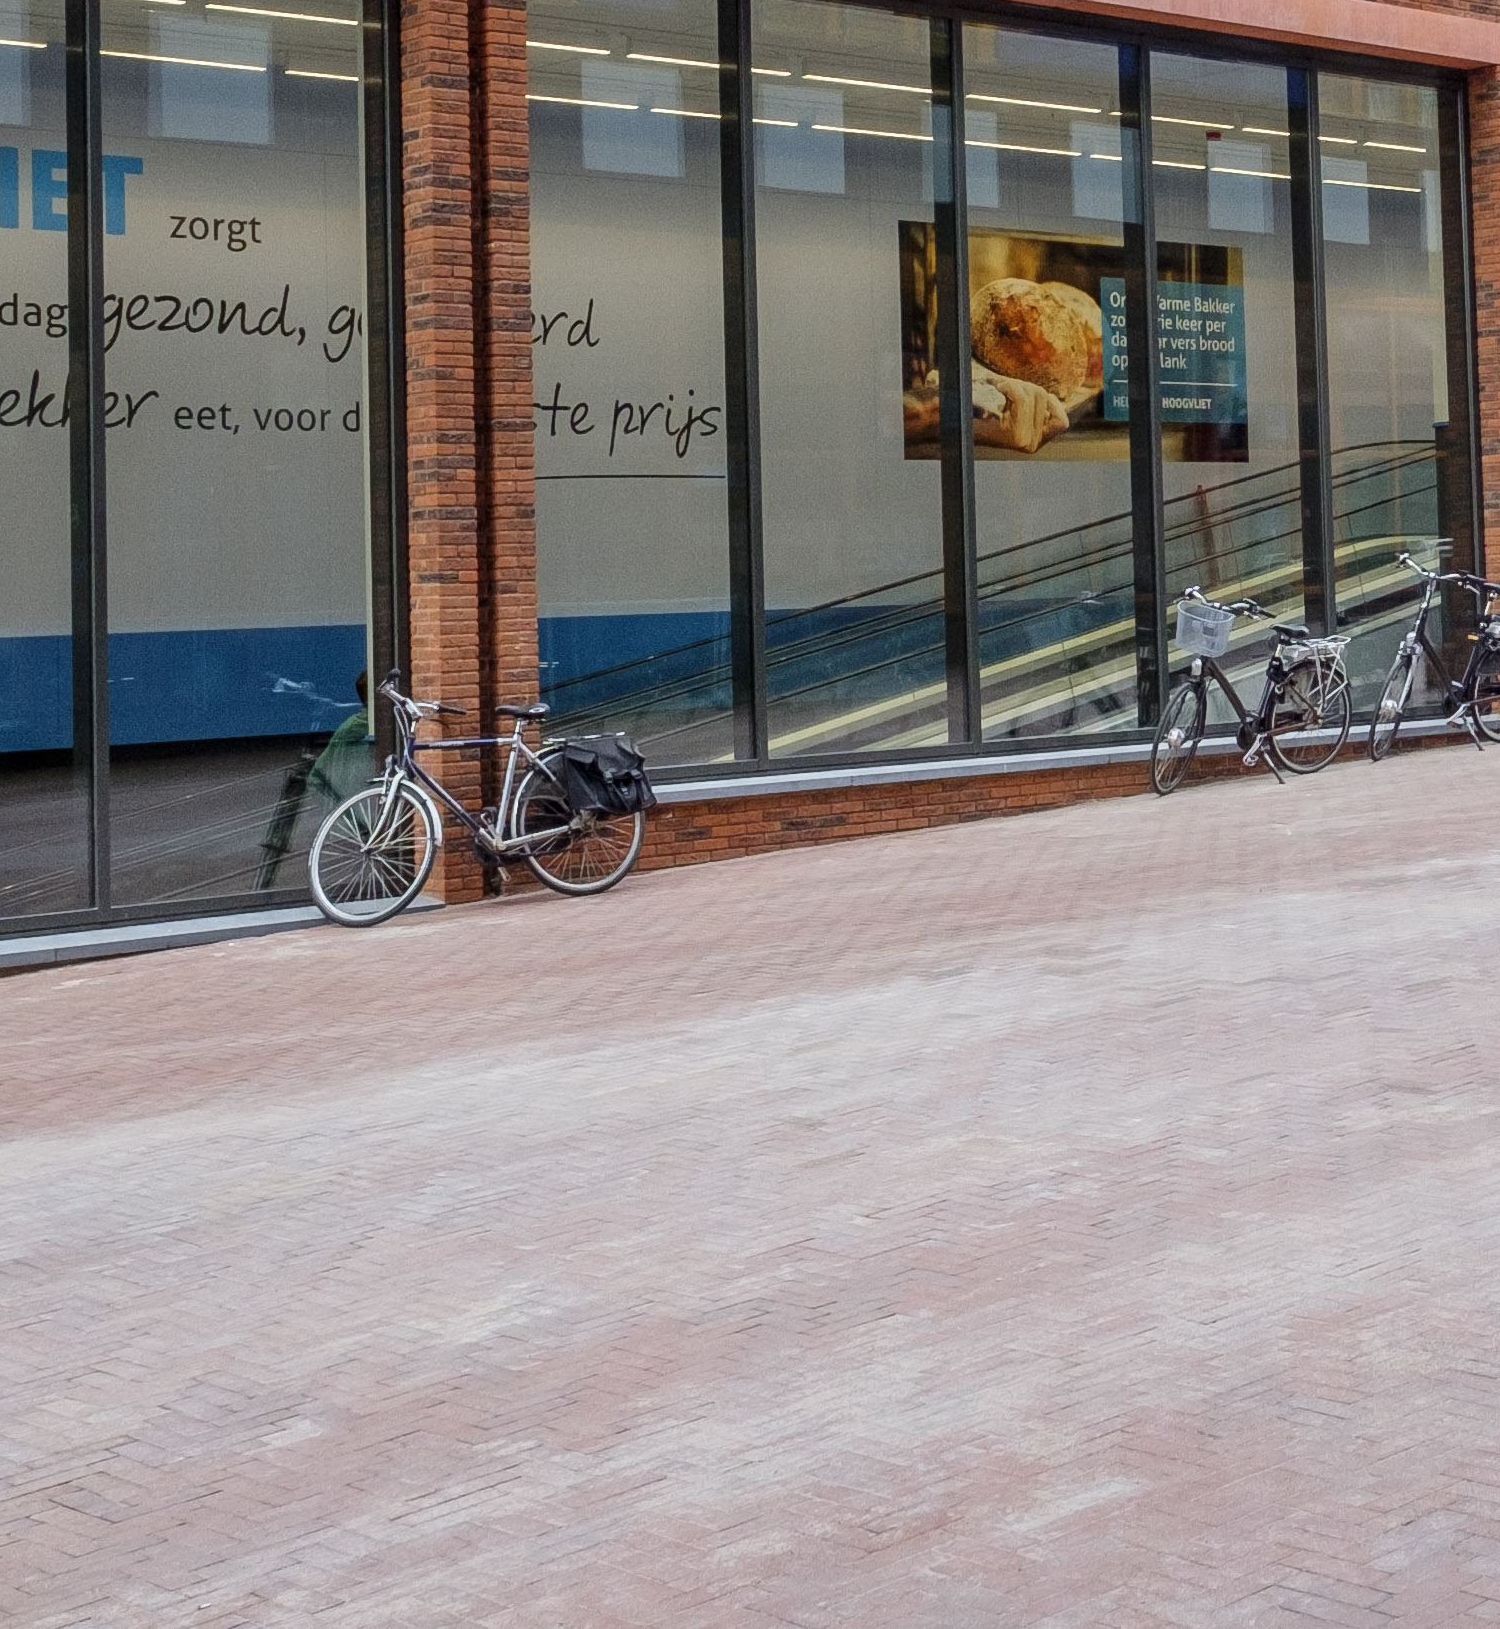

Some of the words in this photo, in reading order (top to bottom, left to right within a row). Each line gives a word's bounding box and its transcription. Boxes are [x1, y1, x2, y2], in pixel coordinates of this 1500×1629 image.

[170, 215, 262, 252] zorgt
[1156, 295, 1191, 312] arme
[1194, 296, 1235, 314] Bakker
[102, 284, 306, 353] gezond,
[1175, 315, 1203, 331] keer
[1205, 319, 1227, 336] per
[1111, 331, 1128, 347] da
[1170, 337, 1197, 350] vers
[1199, 335, 1235, 352] brood
[1159, 352, 1188, 369] lank
[1162, 397, 1212, 410] HOOGVLIET
[174, 403, 240, 435] eet,
[253, 408, 332, 432] voor
[607, 388, 721, 459] prijs
